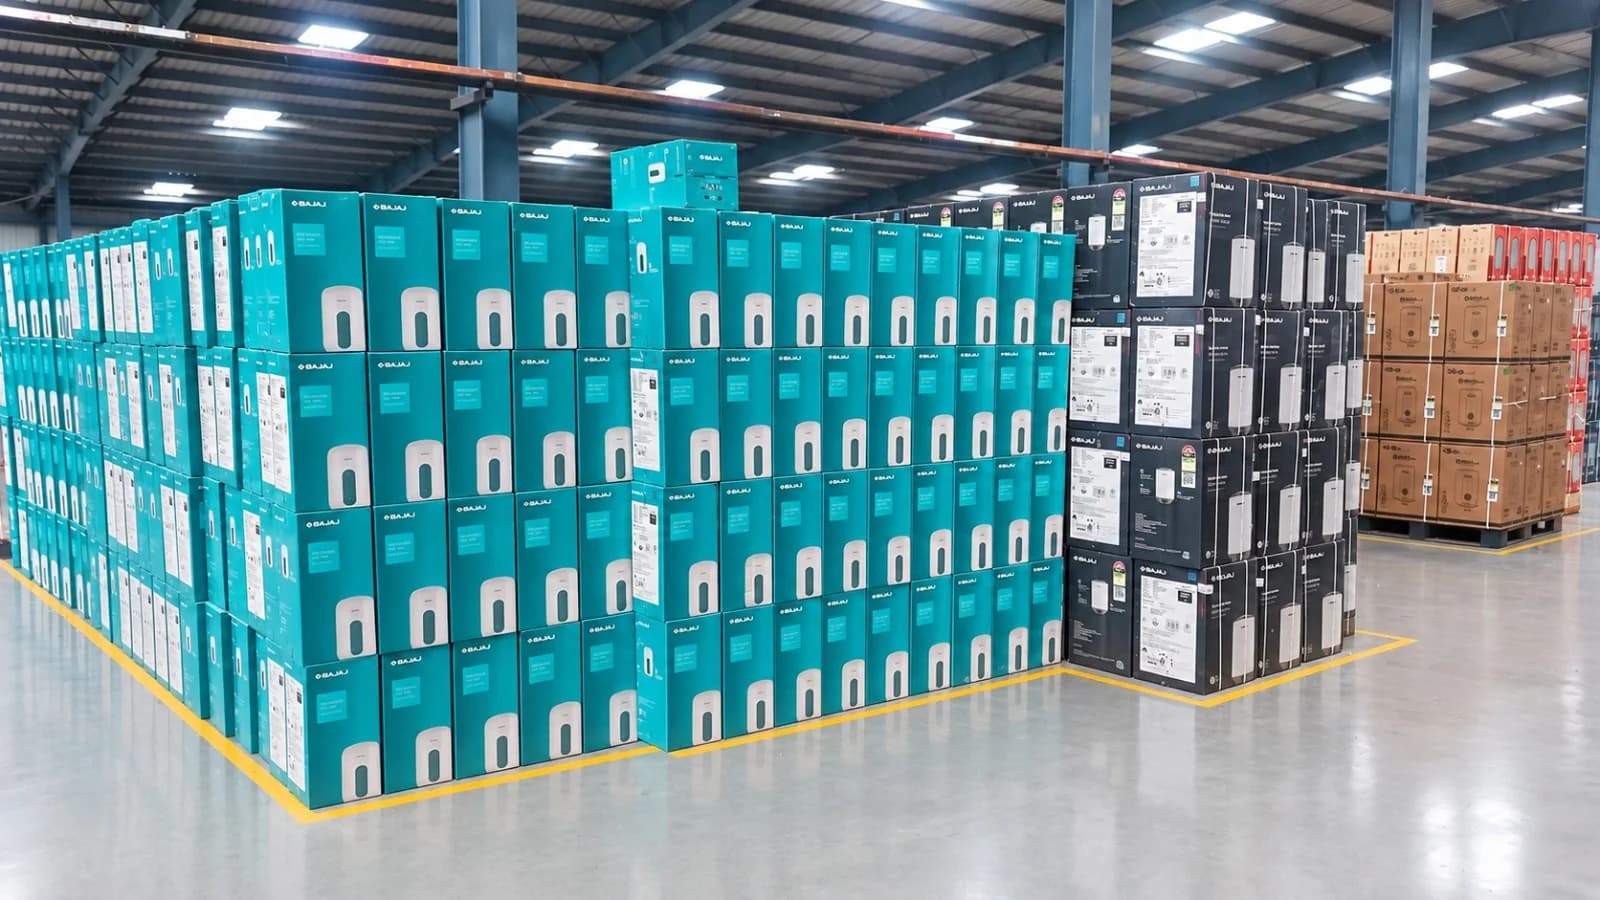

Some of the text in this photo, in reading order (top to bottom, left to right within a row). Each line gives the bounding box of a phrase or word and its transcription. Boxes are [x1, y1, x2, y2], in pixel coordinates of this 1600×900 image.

[1144, 183, 1172, 192] BAJAJ
[312, 519, 340, 528] BAJAJ
[1145, 566, 1168, 576] BAJAJ
[594, 624, 616, 633] BAJAJ
[532, 634, 556, 643] BAJAJ
[467, 643, 491, 653] BAJAJ
[396, 655, 422, 665] BAJAJ
[321, 669, 349, 679] BAJAJ
